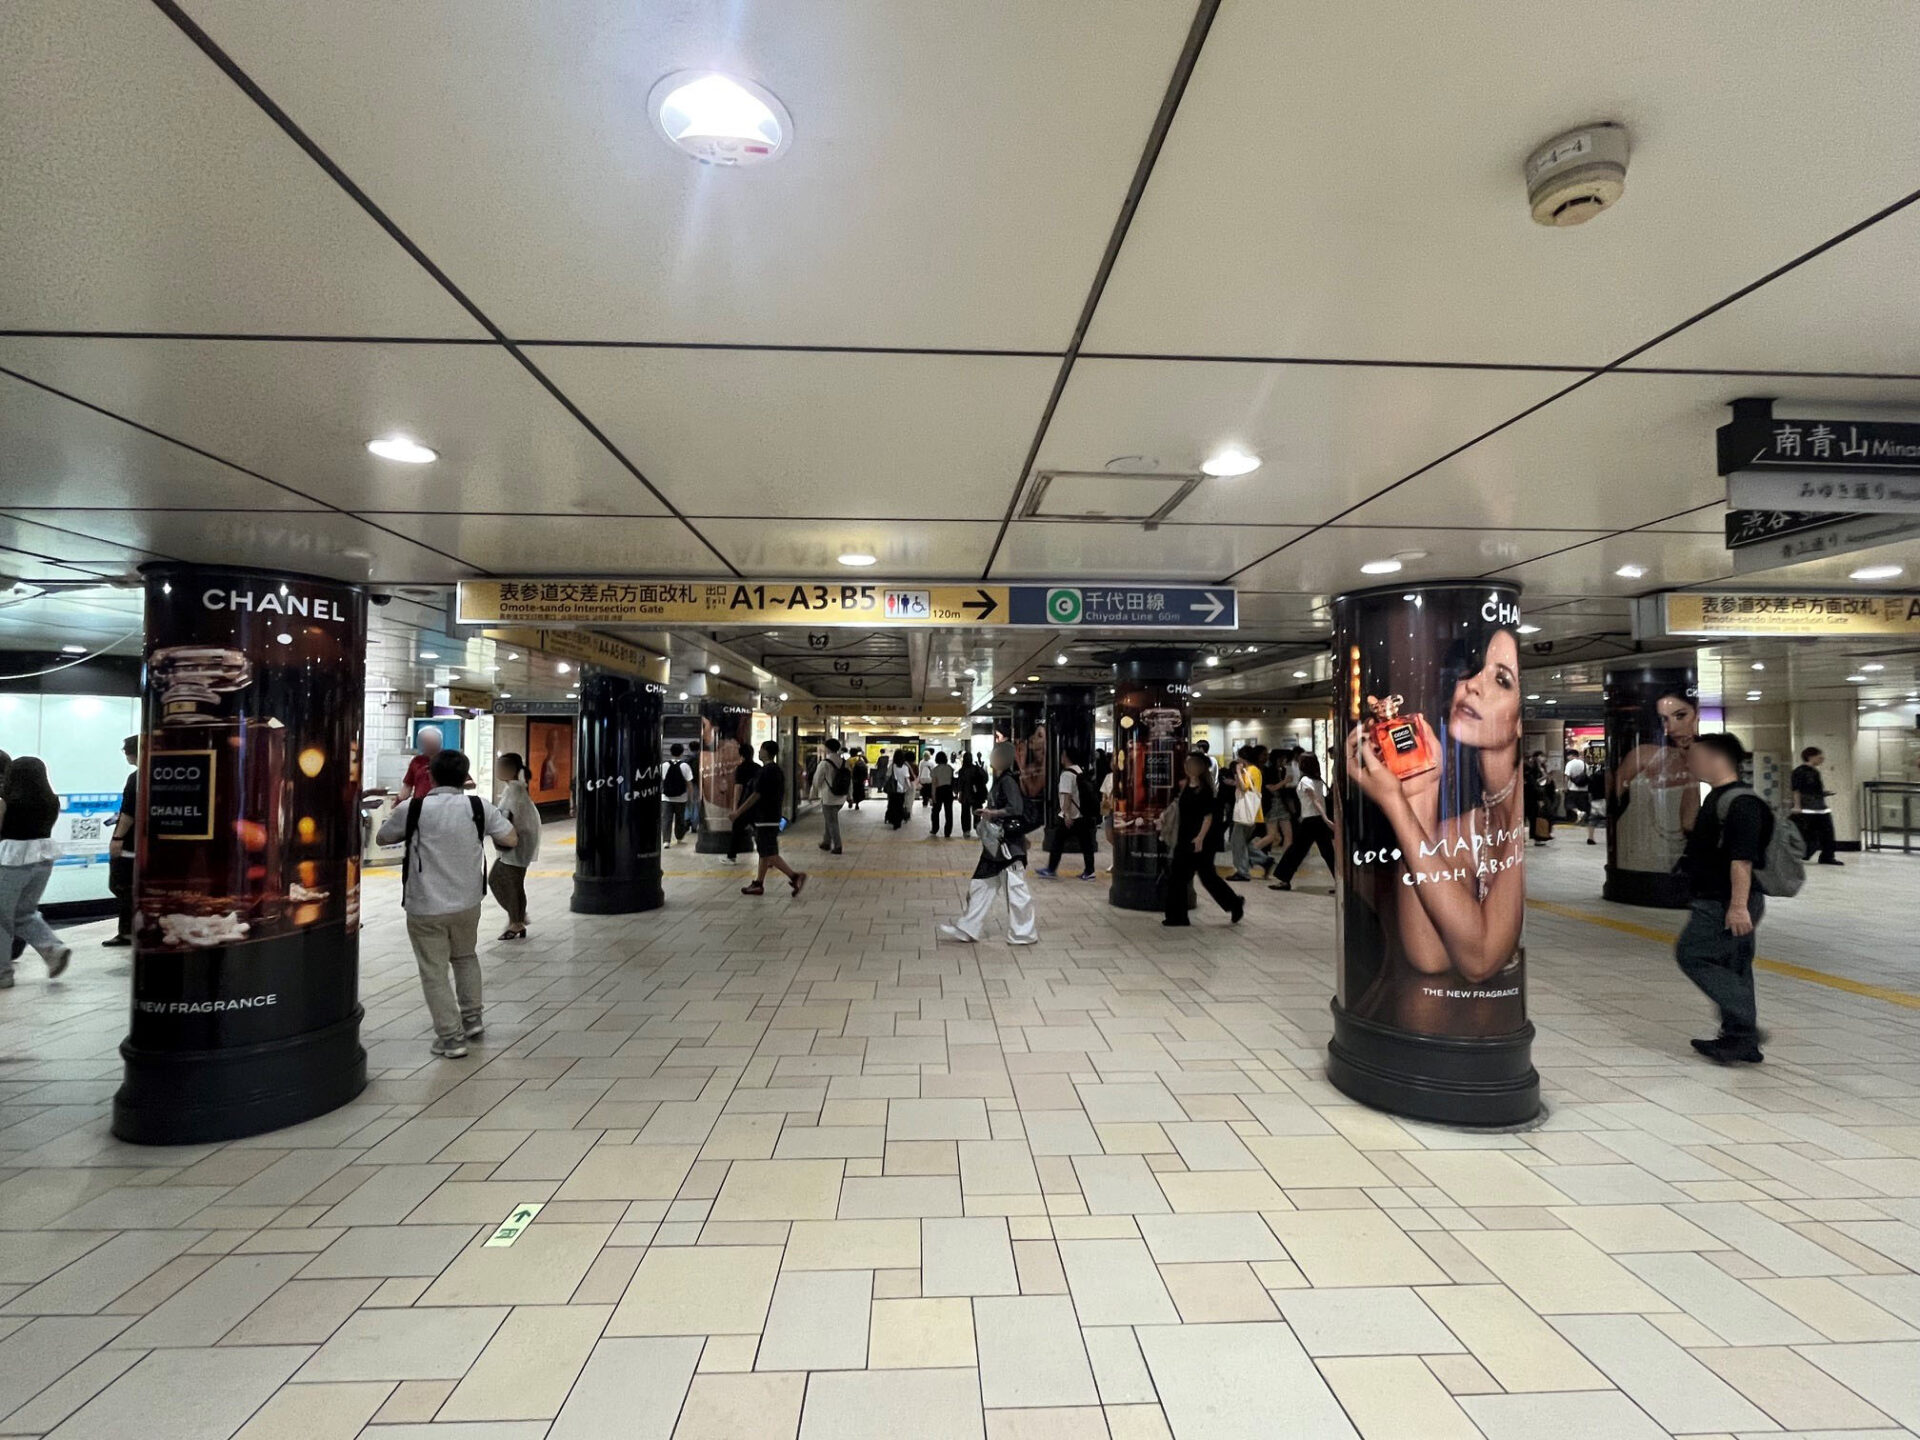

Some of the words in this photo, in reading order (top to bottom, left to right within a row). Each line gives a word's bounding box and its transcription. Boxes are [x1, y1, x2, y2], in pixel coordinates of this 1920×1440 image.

[1773, 424, 1868, 457] 南青山
[1800, 482, 1884, 500] みゆき通り
[500, 583, 697, 603] 表参道交差点方面改札
[1086, 592, 1165, 611] 千代田線
[202, 588, 346, 622] CHANEL
[500, 603, 571, 613] Omote-sando
[574, 603, 636, 614] Intersection
[639, 604, 664, 614] Gate
[933, 609, 961, 619] 120m
[1058, 600, 1068, 612] C
[1481, 602, 1520, 626] CHA
[1702, 596, 1877, 615] 表参道交差点方面改札
[1086, 611, 1128, 622] Chiyoda
[1132, 612, 1153, 621] Line
[153, 767, 201, 780] COCO
[586, 775, 624, 792] COCO
[635, 764, 662, 782] MA
[150, 806, 203, 817] CHANEL
[1353, 847, 1401, 866] COCO
[1402, 868, 1466, 886] CRUSH
[1423, 987, 1444, 996] THE
[1446, 989, 1471, 998] NEW
[1473, 987, 1519, 998] FRAGRANCE
[169, 993, 277, 1014] FRAGRANCE
